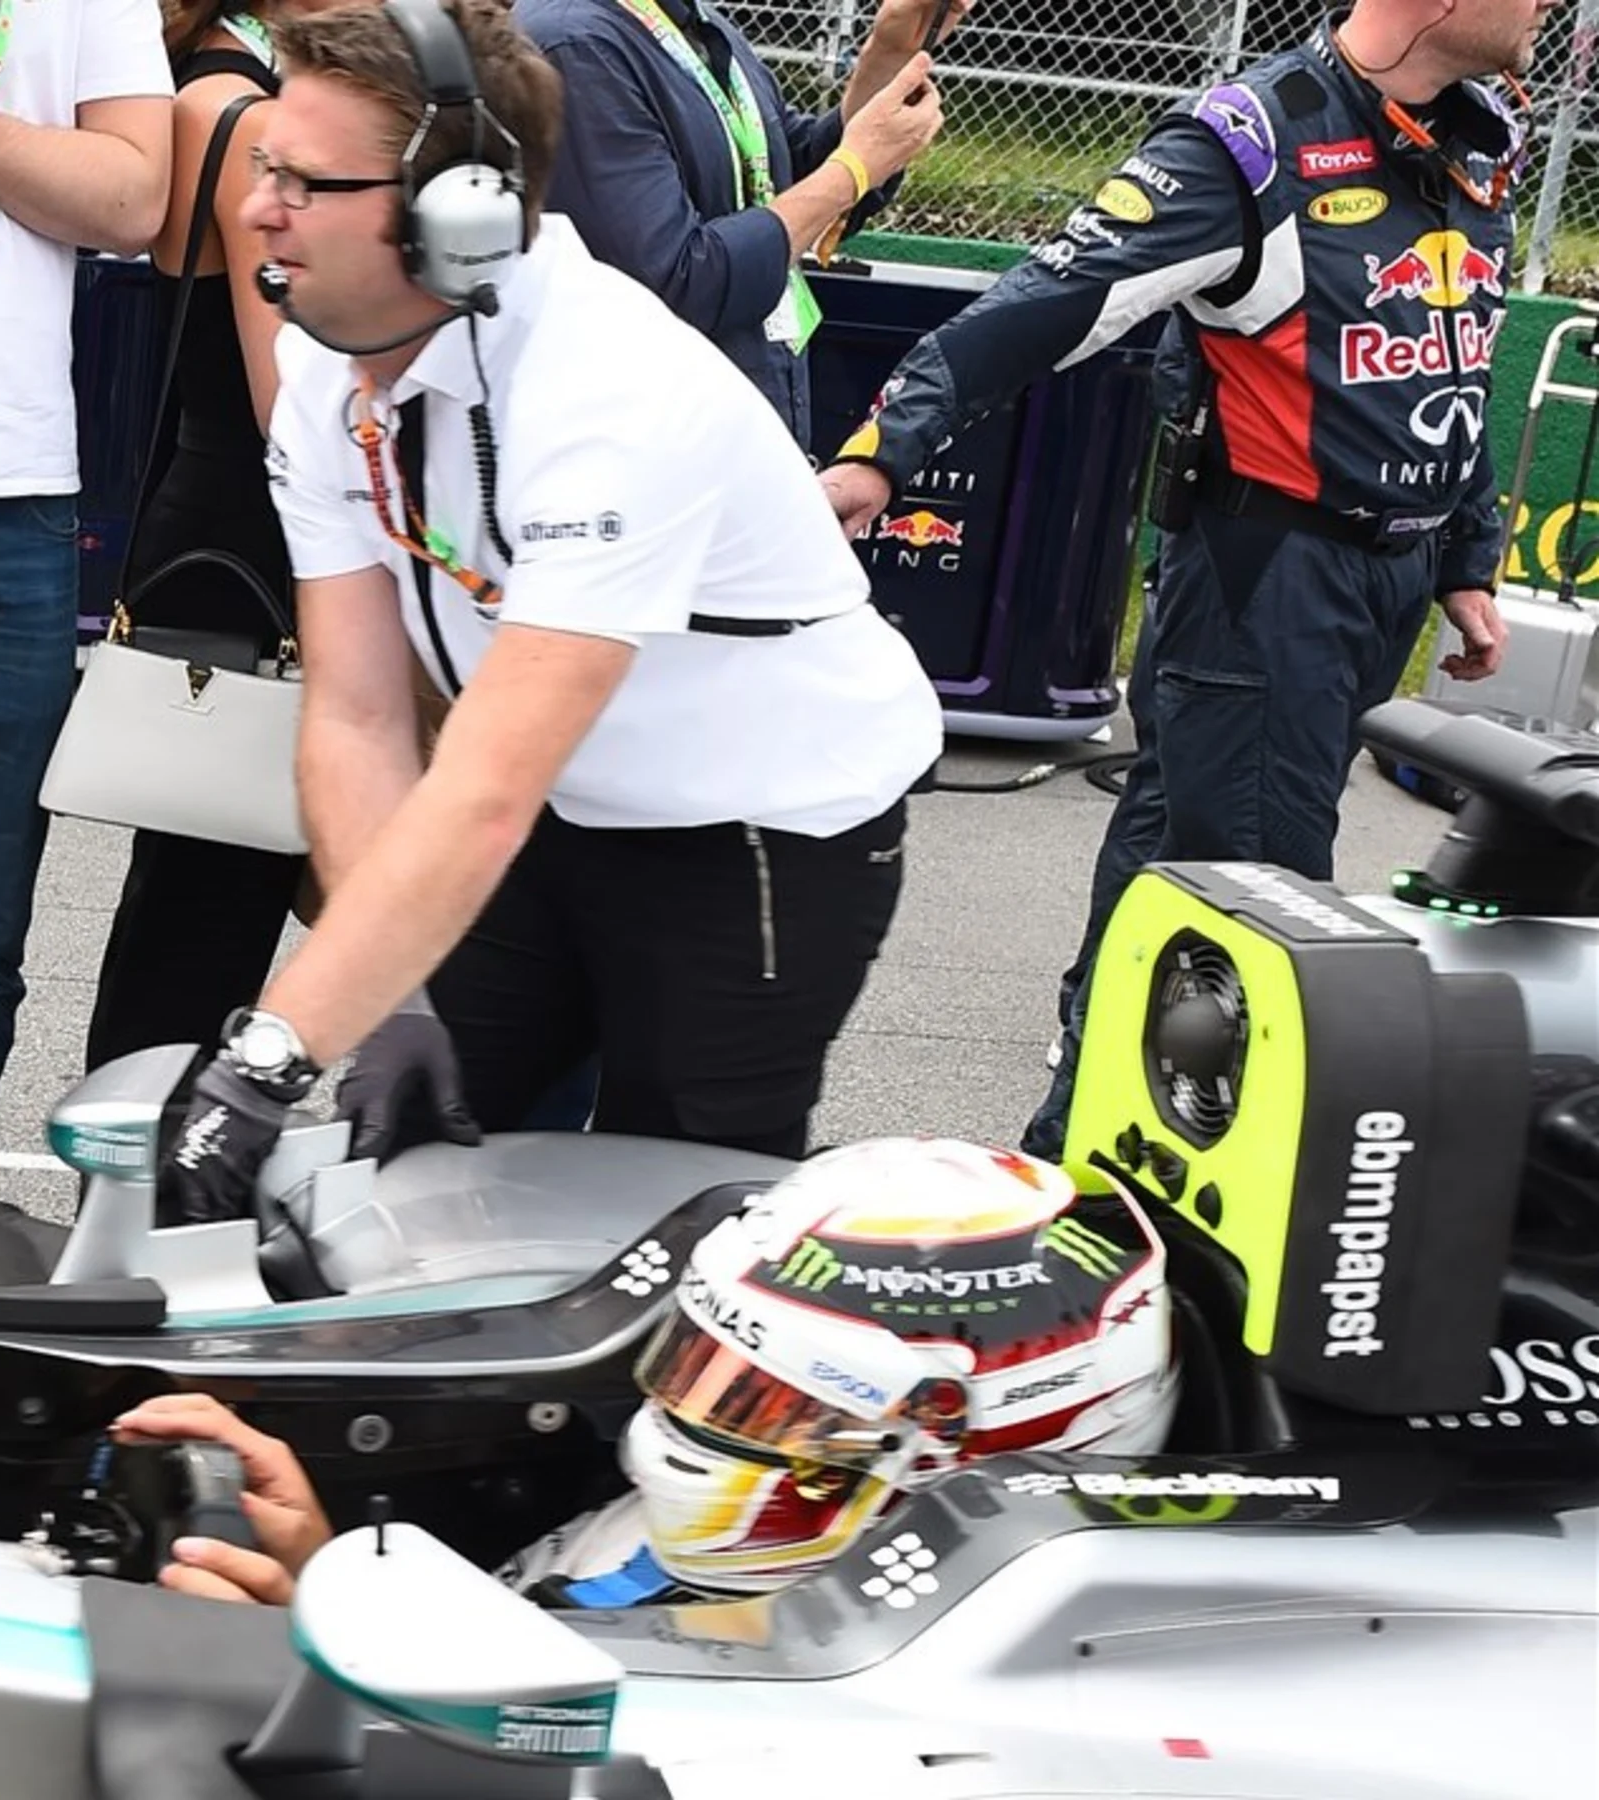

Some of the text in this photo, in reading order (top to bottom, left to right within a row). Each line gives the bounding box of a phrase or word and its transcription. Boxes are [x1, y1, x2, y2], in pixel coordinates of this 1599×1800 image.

[1302, 150, 1373, 171] TOTAL
[1341, 312, 1452, 386] Red
[1319, 1110, 1415, 1357] ebmpapst
[842, 1261, 1053, 1298] MONSTER
[871, 1299, 1021, 1316] ENERGY
[1407, 1411, 1523, 1430] HUGO
[1070, 1473, 1341, 1501] BlackBerry
